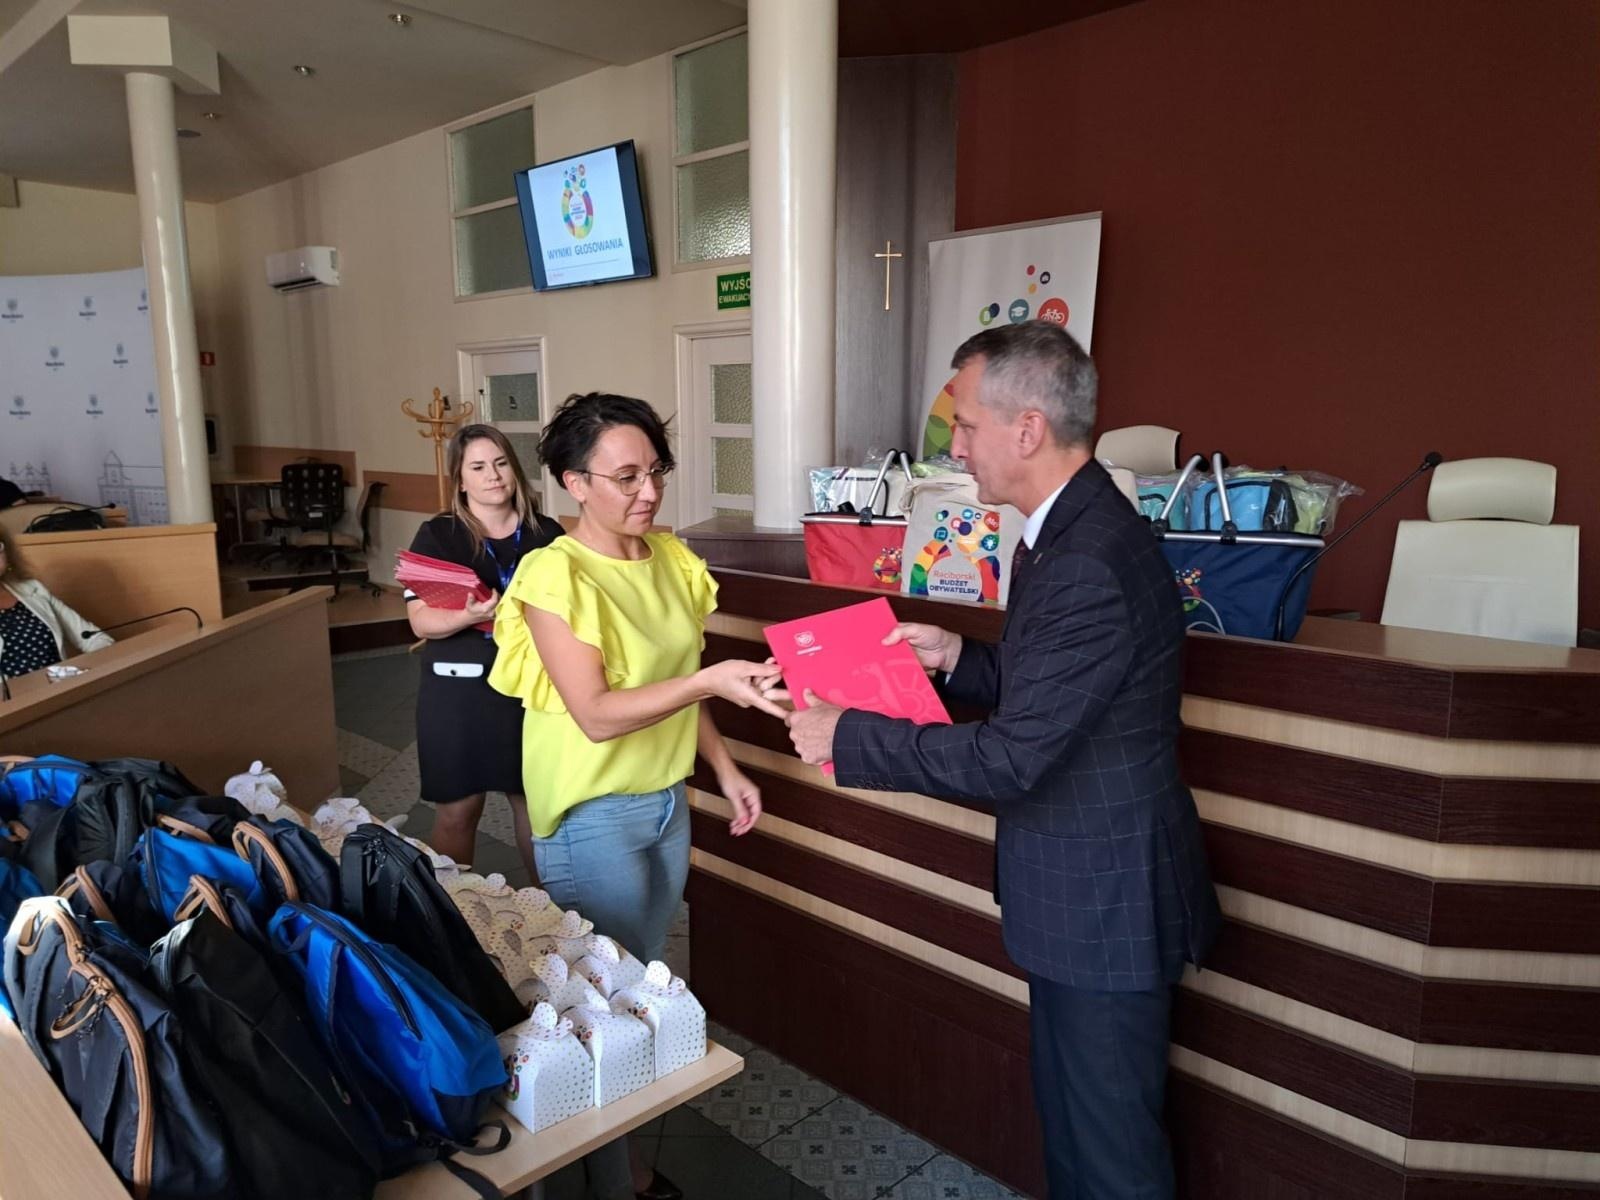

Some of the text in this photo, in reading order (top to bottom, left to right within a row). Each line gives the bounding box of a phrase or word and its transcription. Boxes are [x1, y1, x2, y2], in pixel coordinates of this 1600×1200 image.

[547, 237, 625, 259] WYNIKI GŁOSOWANIA
[720, 276, 751, 292] WYJŚC
[718, 293, 751, 304] EWAKUAC
[929, 585, 979, 595] OBYWATELSKI
